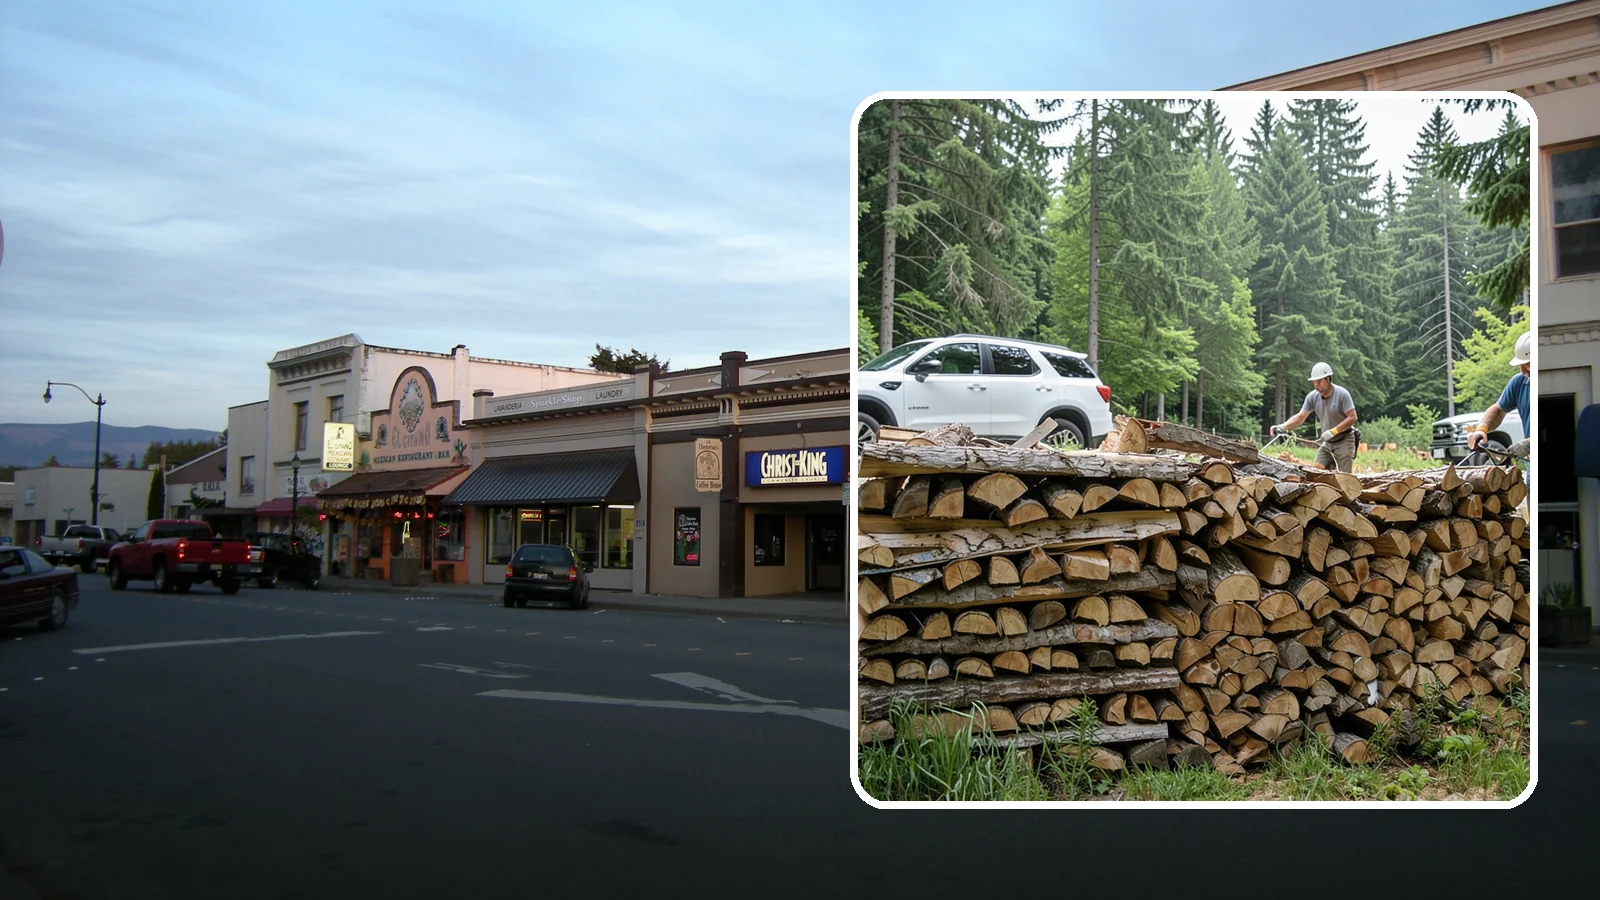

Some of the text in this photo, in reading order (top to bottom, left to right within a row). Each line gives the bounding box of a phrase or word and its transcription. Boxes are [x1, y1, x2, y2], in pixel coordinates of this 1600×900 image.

[595, 389, 623, 400] LAUNDRY
[493, 400, 523, 412] LAVANDERIA
[530, 394, 582, 409] Sparkle Shop
[397, 451, 433, 462] RESTAURANT
[438, 450, 450, 459] BAR
[760, 450, 827, 478] CHRIST KING
